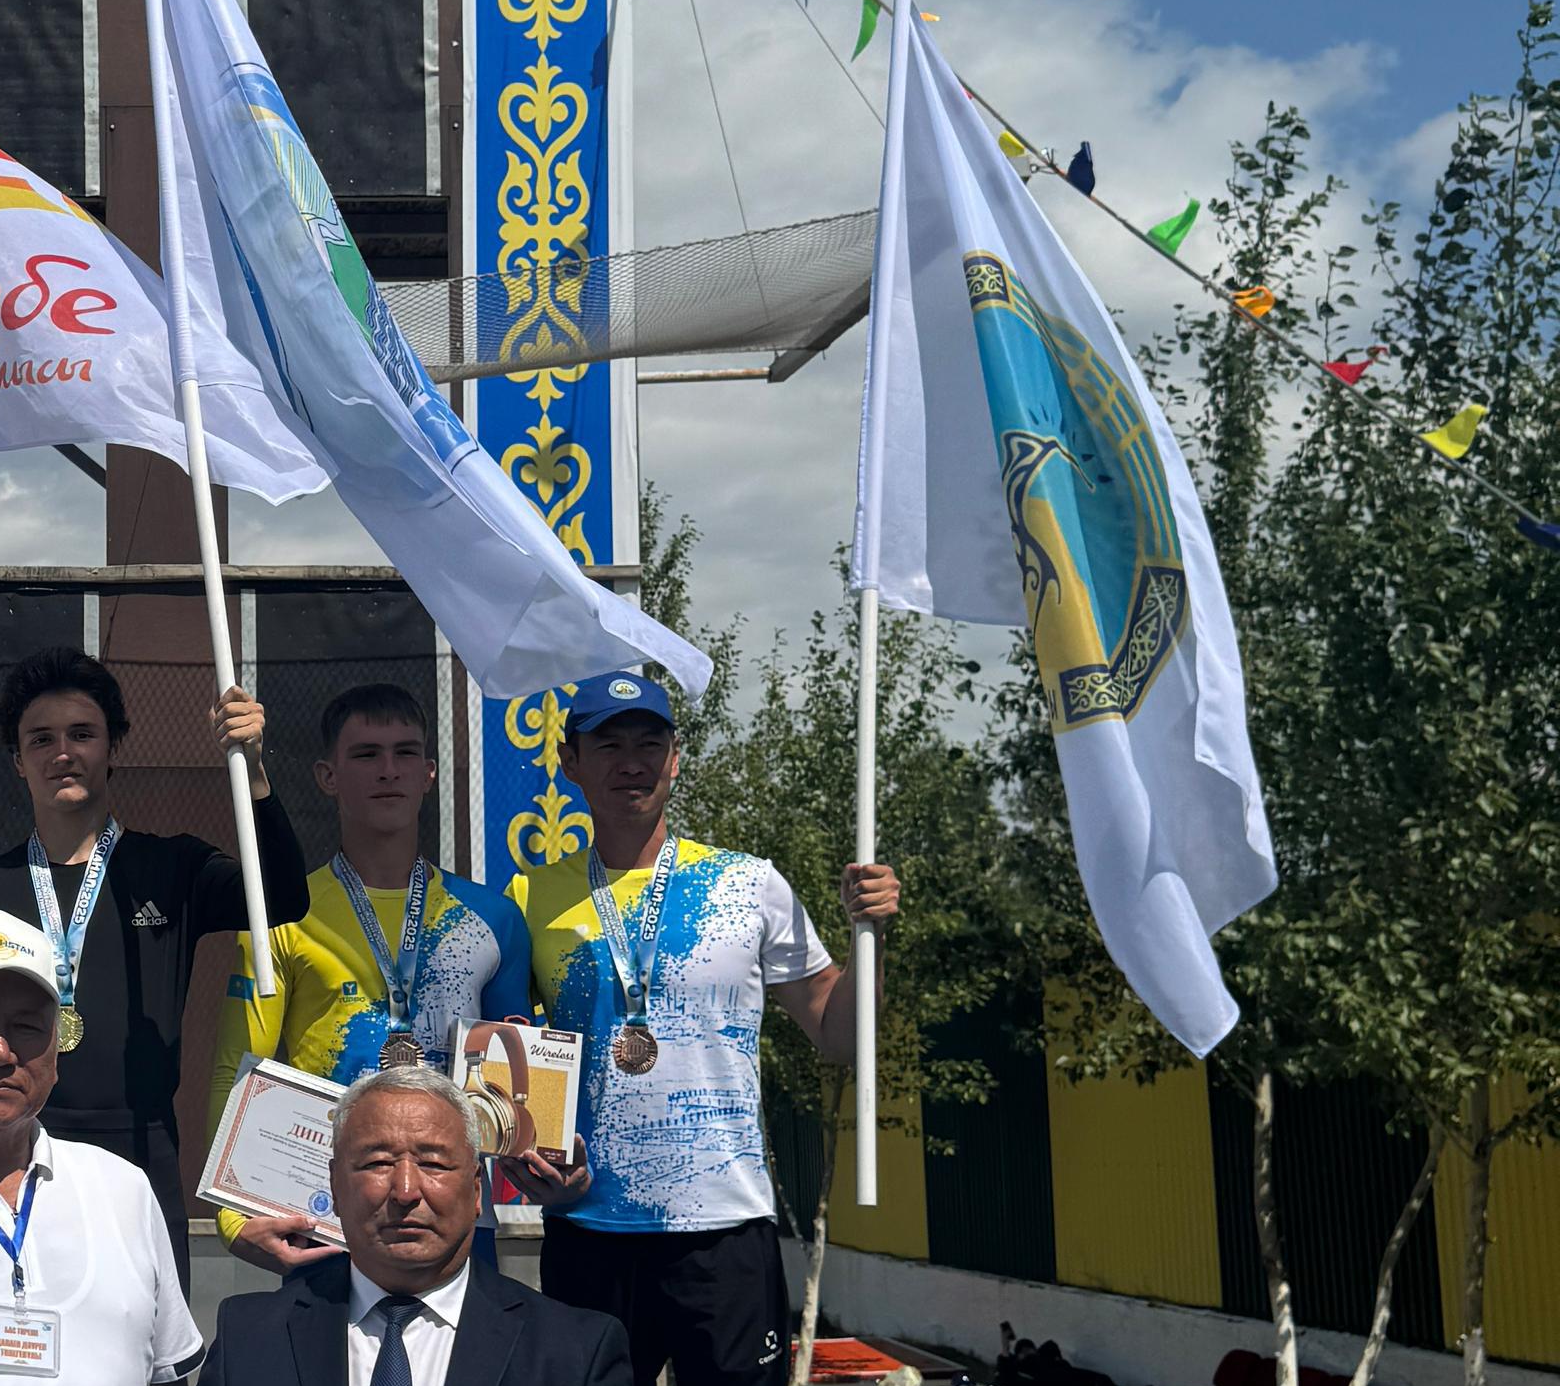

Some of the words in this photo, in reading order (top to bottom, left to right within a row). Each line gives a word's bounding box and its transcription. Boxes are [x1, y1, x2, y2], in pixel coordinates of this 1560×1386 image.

[131, 916, 168, 926] adidas
[530, 1044, 575, 1061] Wireless
[287, 1123, 333, 1148] ДИПЛ
